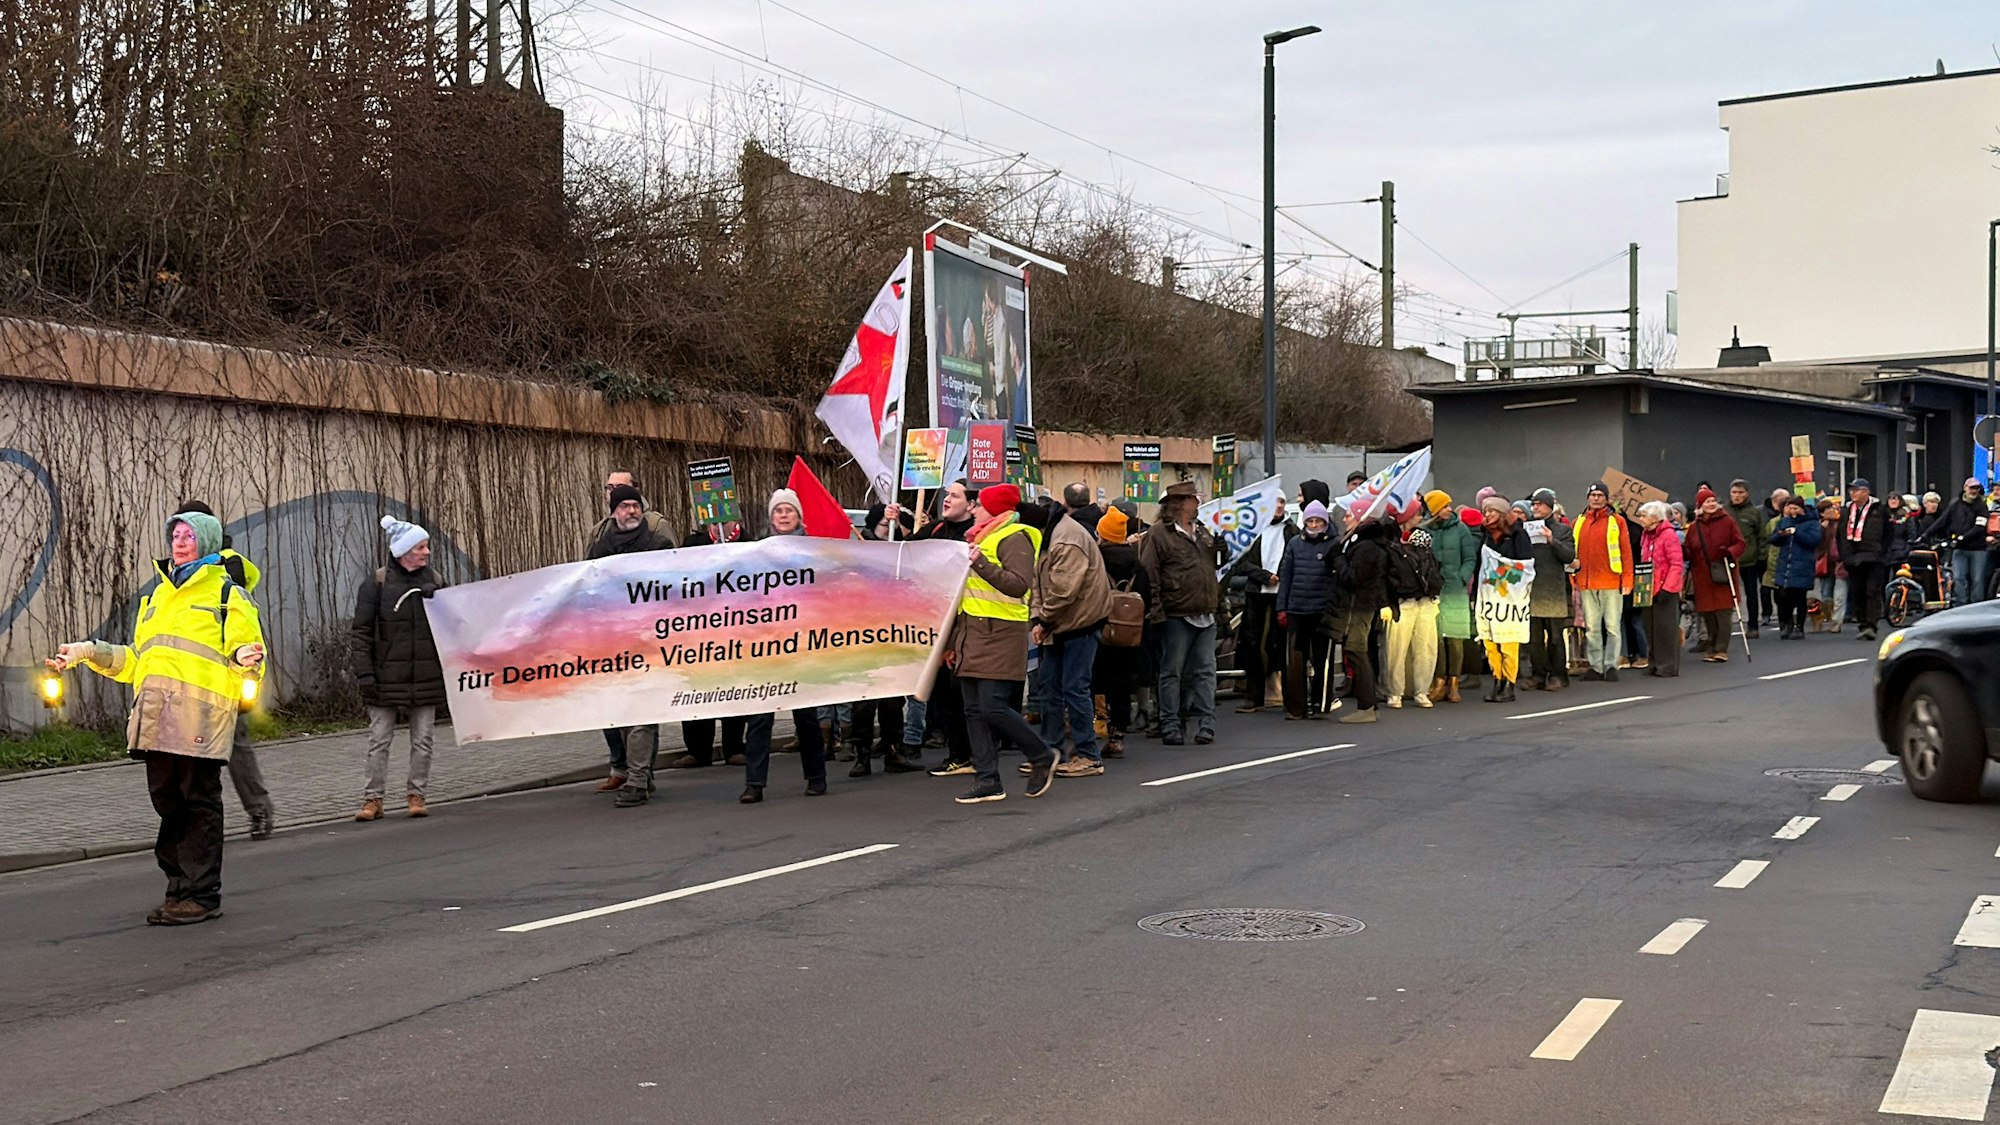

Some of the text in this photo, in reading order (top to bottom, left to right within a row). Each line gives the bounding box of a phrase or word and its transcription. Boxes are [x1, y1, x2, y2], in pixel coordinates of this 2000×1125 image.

[972, 439, 991, 449] Rote
[972, 449, 995, 459] Karte
[972, 459, 998, 469] für die
[972, 469, 990, 480] AfD!
[1621, 478, 1648, 498] FCK
[627, 567, 815, 604] Wir in Kerpen
[655, 603, 797, 639] gemeinsam
[458, 671, 494, 692] für
[503, 651, 651, 684] Demokratie,
[660, 639, 743, 666] Vielfalt
[751, 632, 799, 657] und
[671, 680, 798, 706] #niewiederistjetzt
